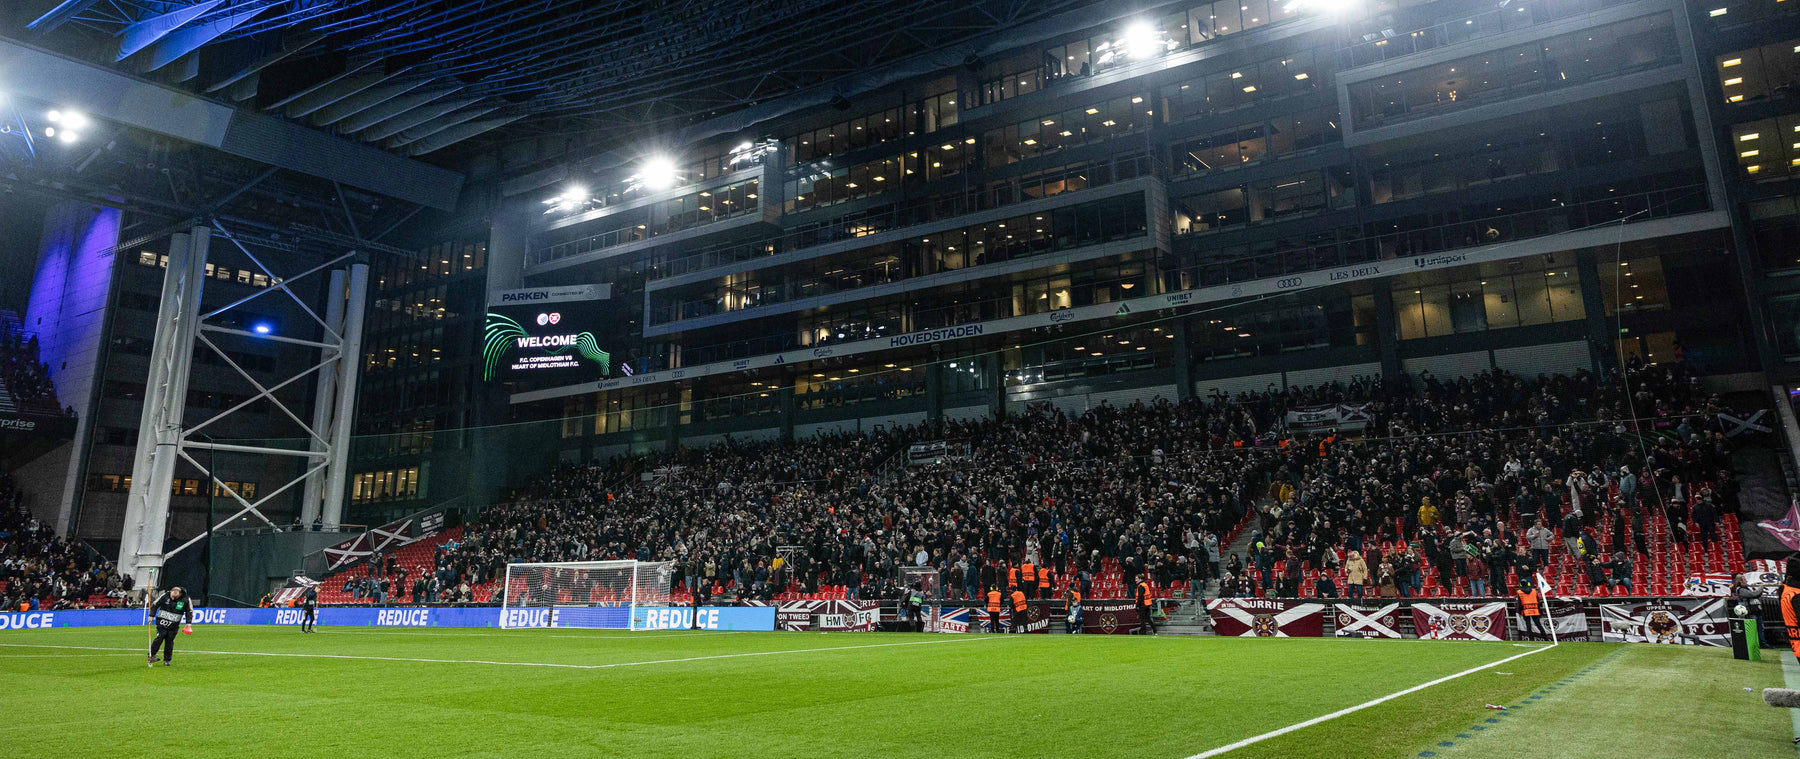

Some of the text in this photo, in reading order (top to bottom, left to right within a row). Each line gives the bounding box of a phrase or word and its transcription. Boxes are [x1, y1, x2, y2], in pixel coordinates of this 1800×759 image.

[1427, 254, 1467, 266] unisport
[1329, 266, 1380, 281] LES DEUX
[502, 291, 549, 302] PARKEN
[1166, 292, 1193, 302] UNIBET
[1050, 311, 1075, 322] Carlsberg
[890, 324, 983, 347] HOVEDSTADEN
[517, 335, 578, 348] WELCOME
[0, 418, 35, 428] prise
[160, 618, 172, 627] 007
[377, 610, 428, 626] REDUCE
[499, 610, 558, 627] REDUCE
[646, 610, 719, 629] REDUCE
[826, 616, 841, 626] HM
[933, 621, 966, 632] HEARTS
